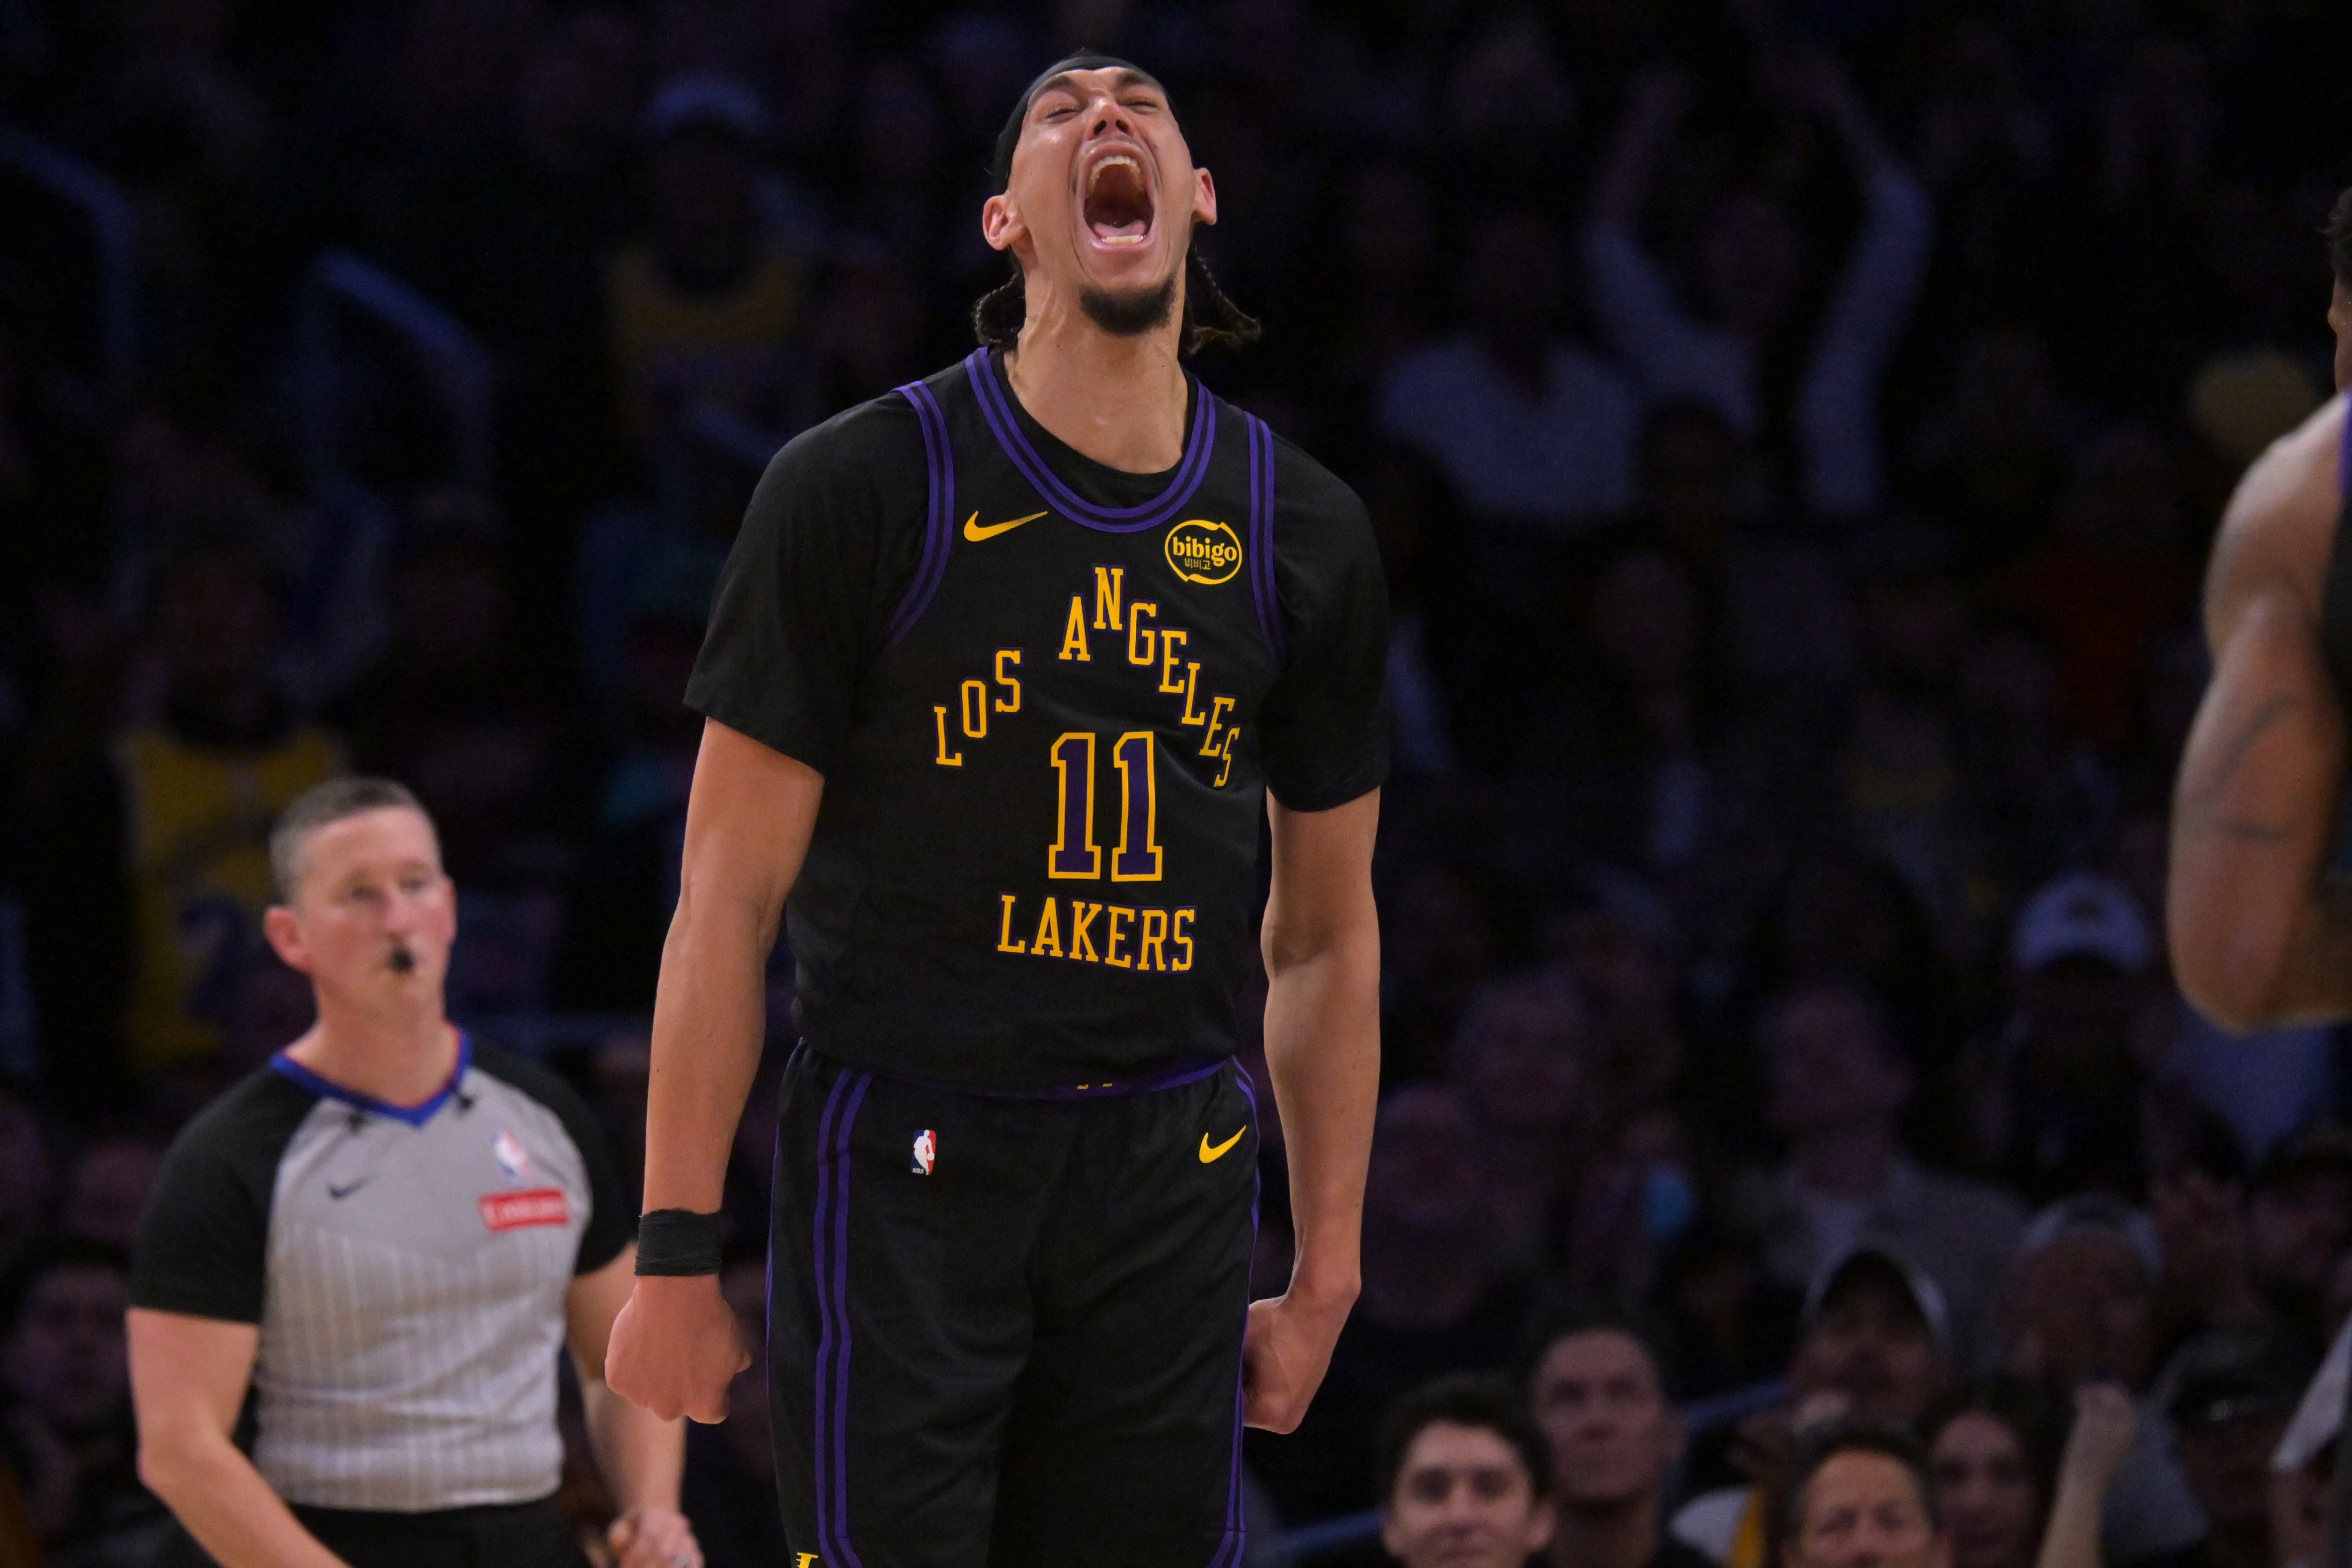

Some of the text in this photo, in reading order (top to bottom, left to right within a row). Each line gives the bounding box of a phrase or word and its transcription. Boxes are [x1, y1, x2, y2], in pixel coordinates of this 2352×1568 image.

[1172, 535, 1238, 567] bibigo
[1184, 557, 1211, 571] 비비고
[932, 566, 1241, 788] LOS ANGELES
[1048, 731, 1163, 883] 11
[996, 894, 1196, 972] LAKERS
